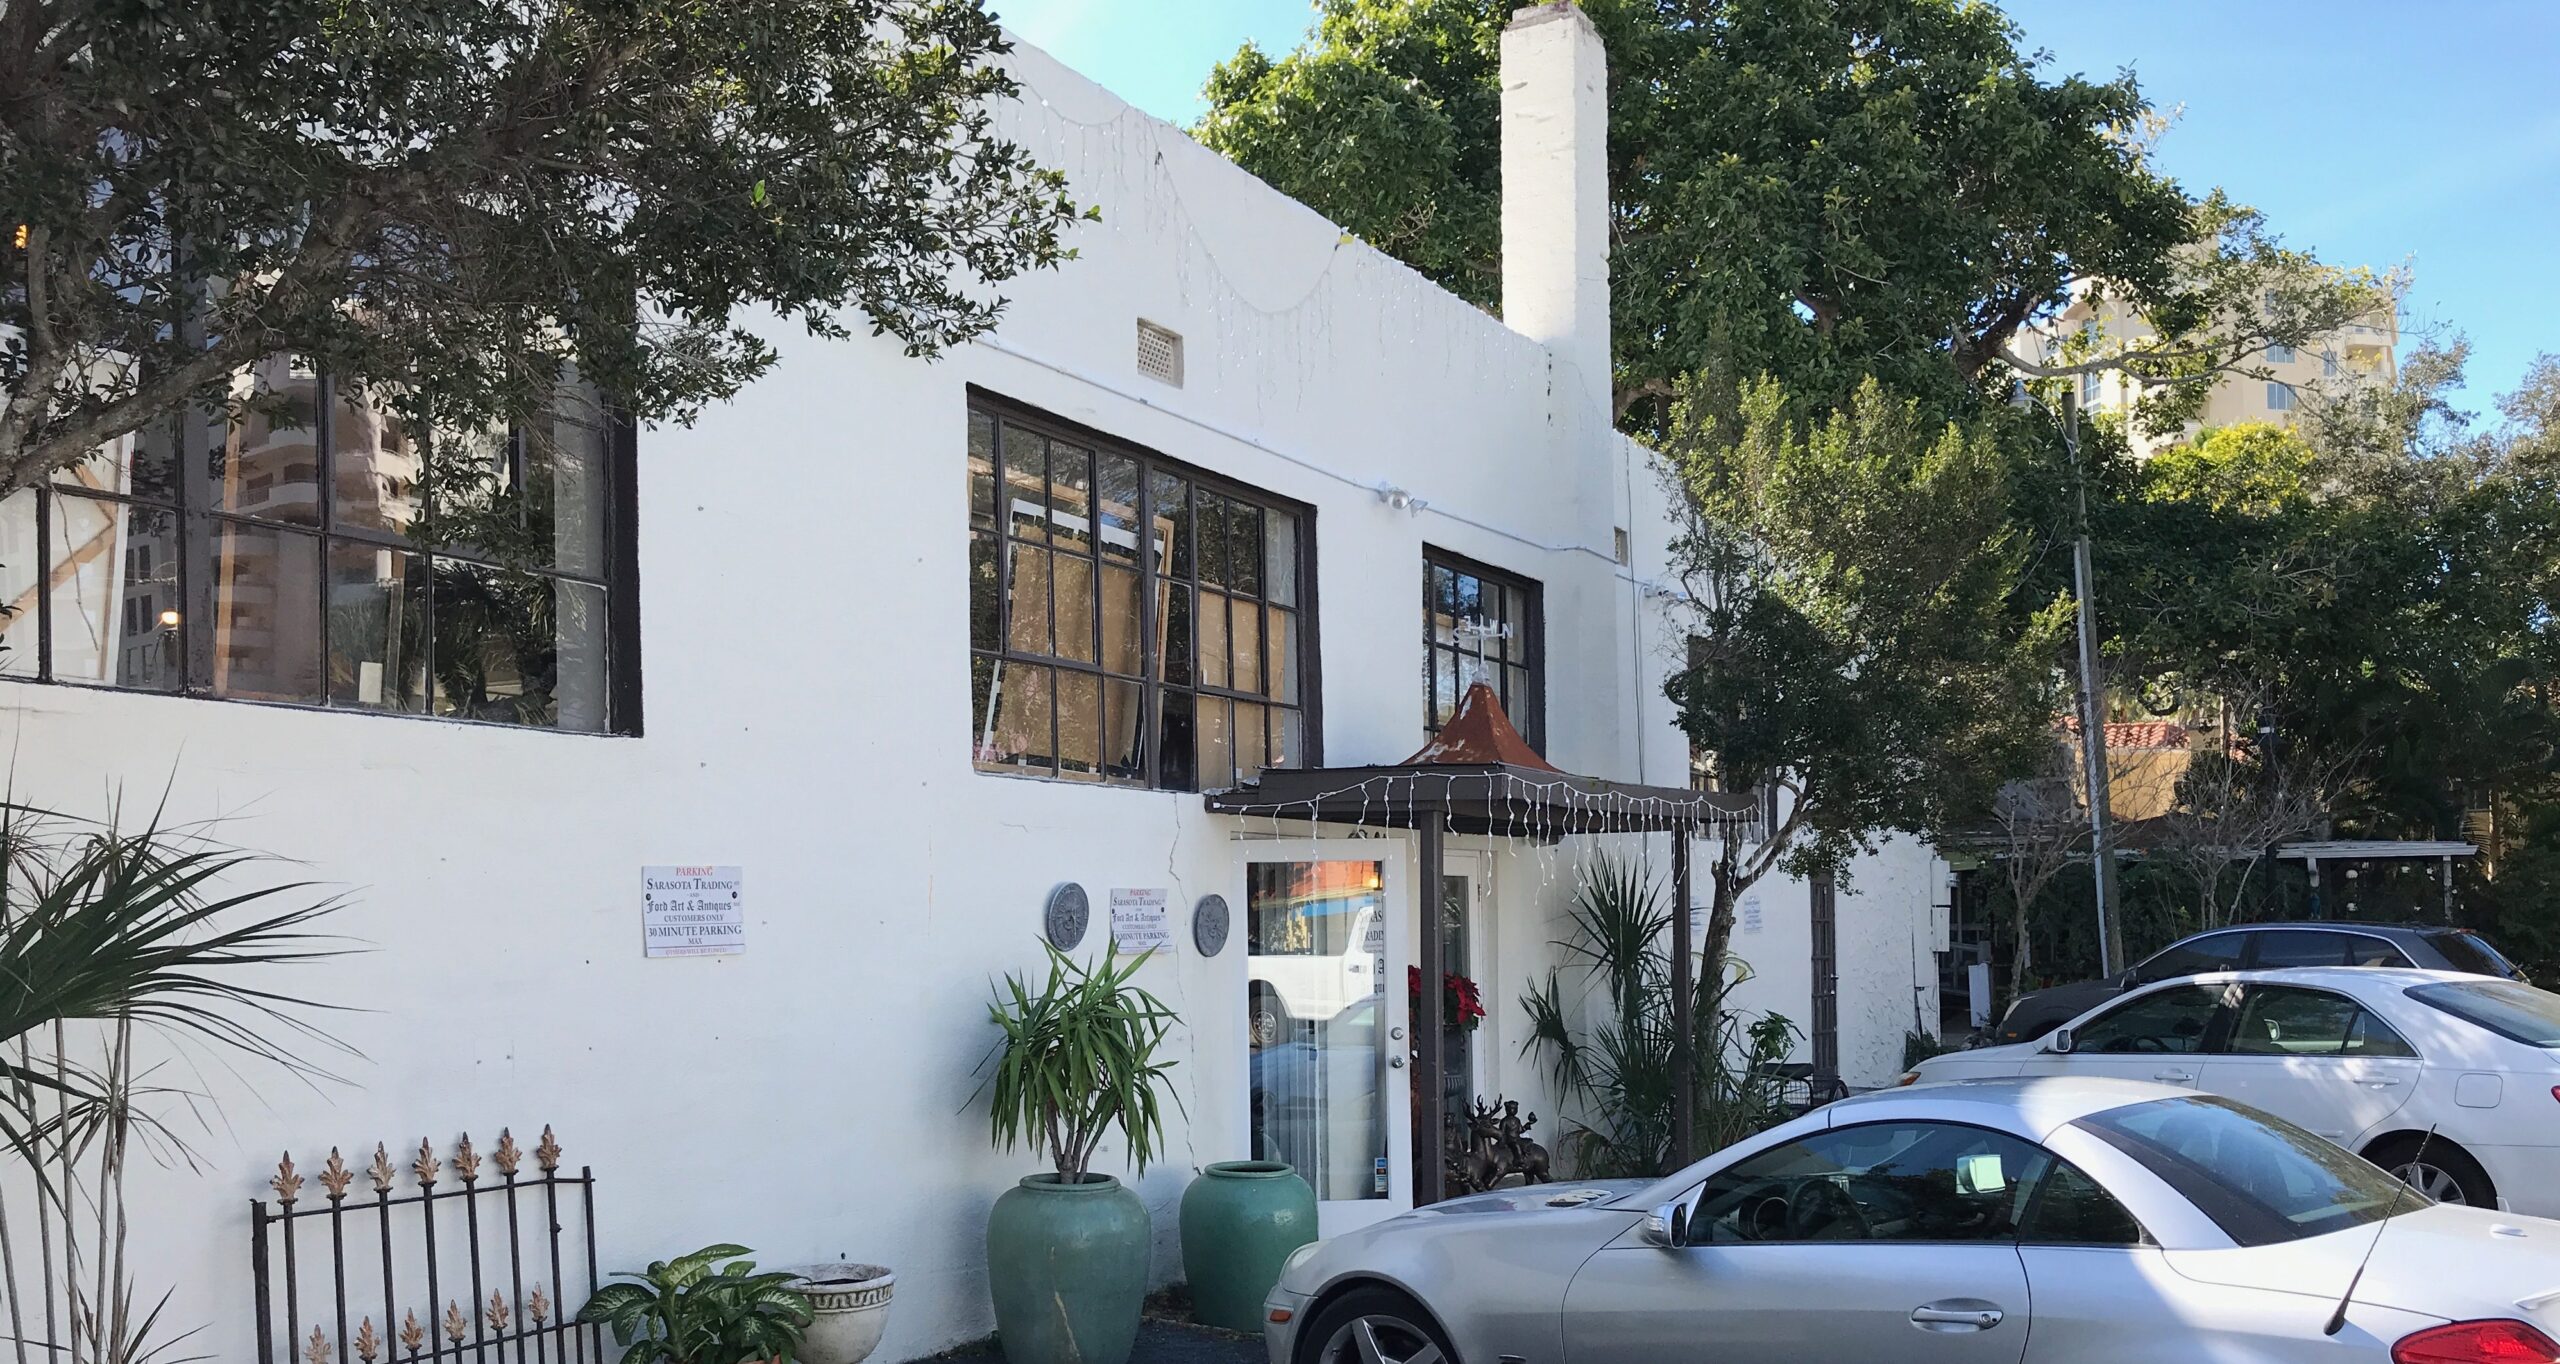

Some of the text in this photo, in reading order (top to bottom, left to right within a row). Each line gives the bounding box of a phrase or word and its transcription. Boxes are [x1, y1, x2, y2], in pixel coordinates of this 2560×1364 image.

[1501, 622, 1514, 640] N
[676, 867, 713, 876] PARKING
[647, 878, 691, 890] SARASOTA
[693, 878, 732, 890] TRADING
[646, 900, 668, 913] Ford
[670, 900, 684, 912] Art
[687, 899, 695, 911] &
[697, 899, 732, 912] Antiques
[1138, 896, 1162, 906] TRADING
[664, 913, 724, 923] CUSTOMERS ONLY
[649, 925, 742, 937] 30 MINUTE PARKING
[1120, 932, 1142, 940] MINUTE
[1143, 931, 1170, 940] PARKING
